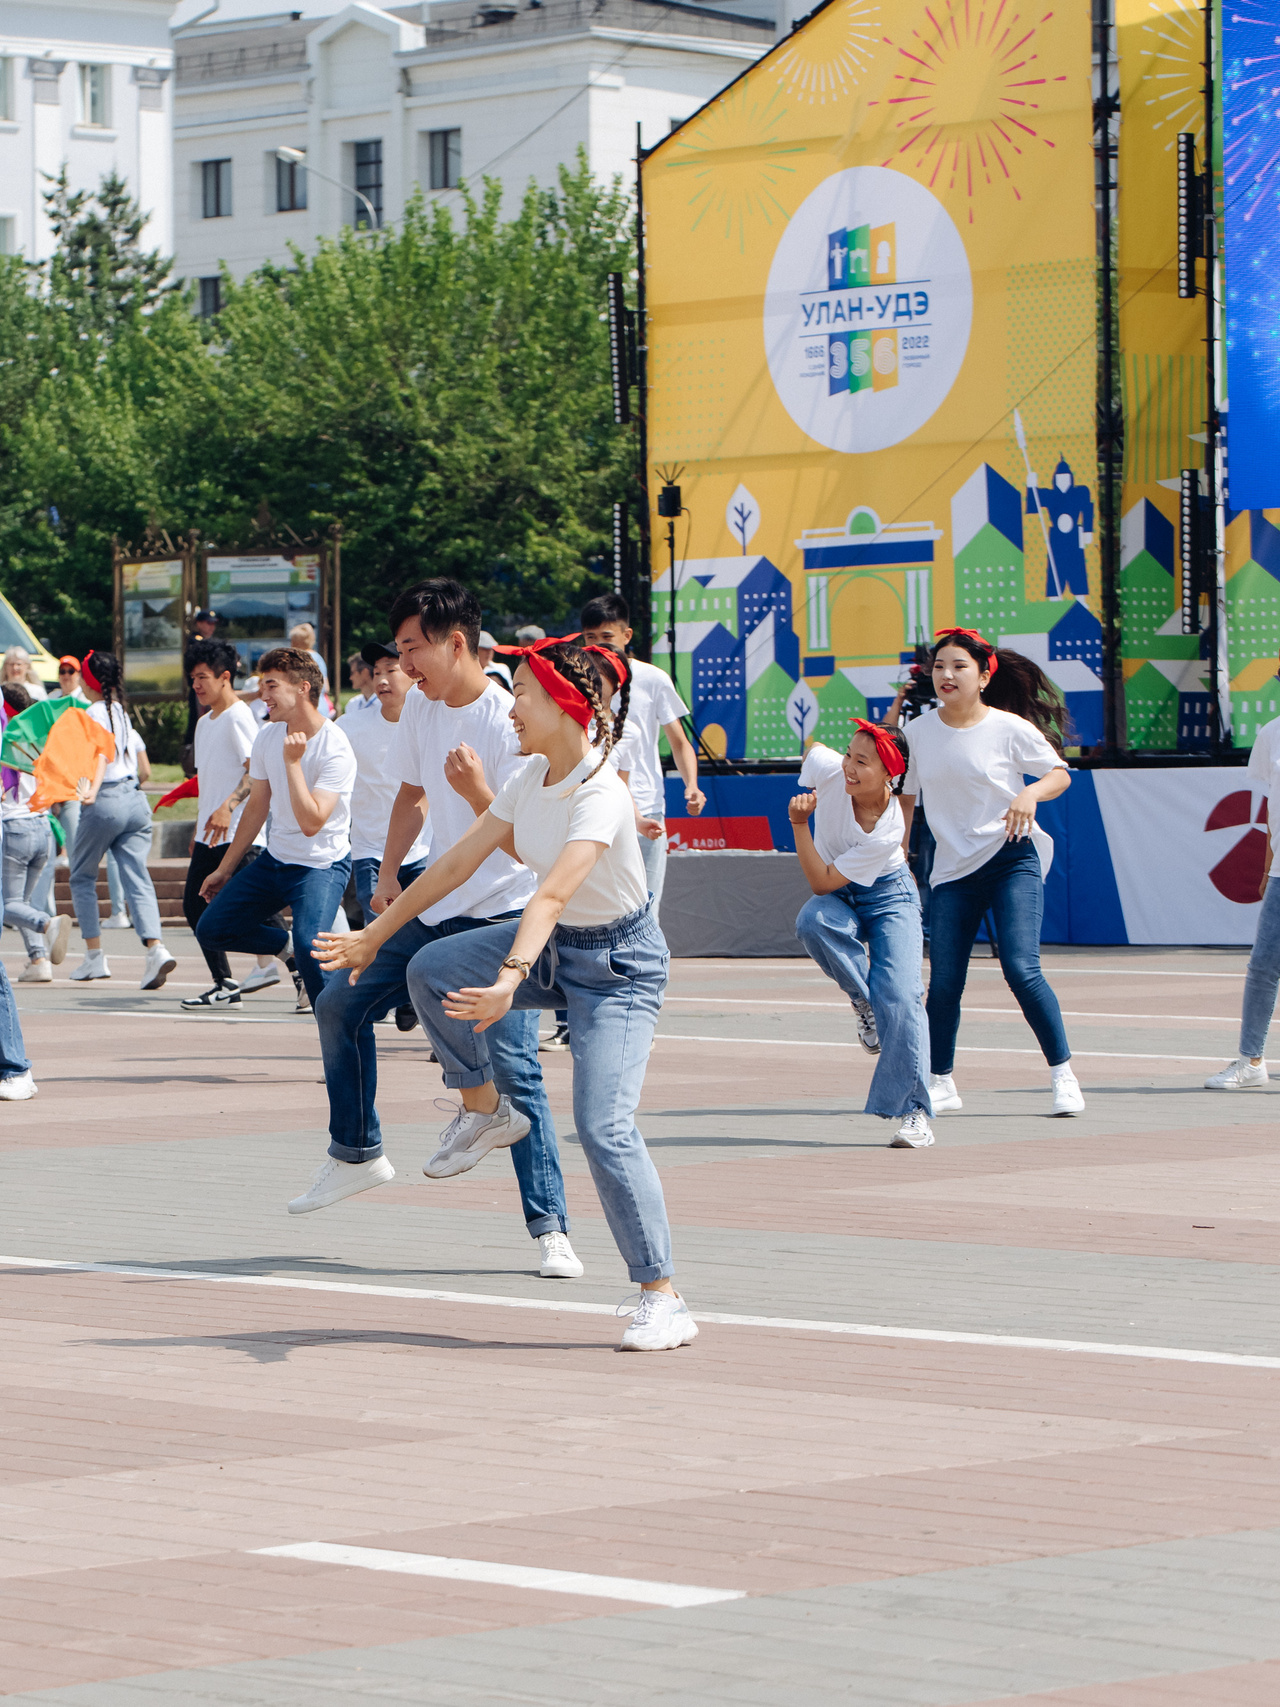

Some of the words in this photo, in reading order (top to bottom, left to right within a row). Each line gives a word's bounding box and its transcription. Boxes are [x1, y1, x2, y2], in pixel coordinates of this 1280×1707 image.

[801, 291, 929, 326] УЛАН-УДЭ
[901, 335, 929, 349] 2022
[829, 337, 897, 379] 356
[692, 838, 726, 848] RADIO
